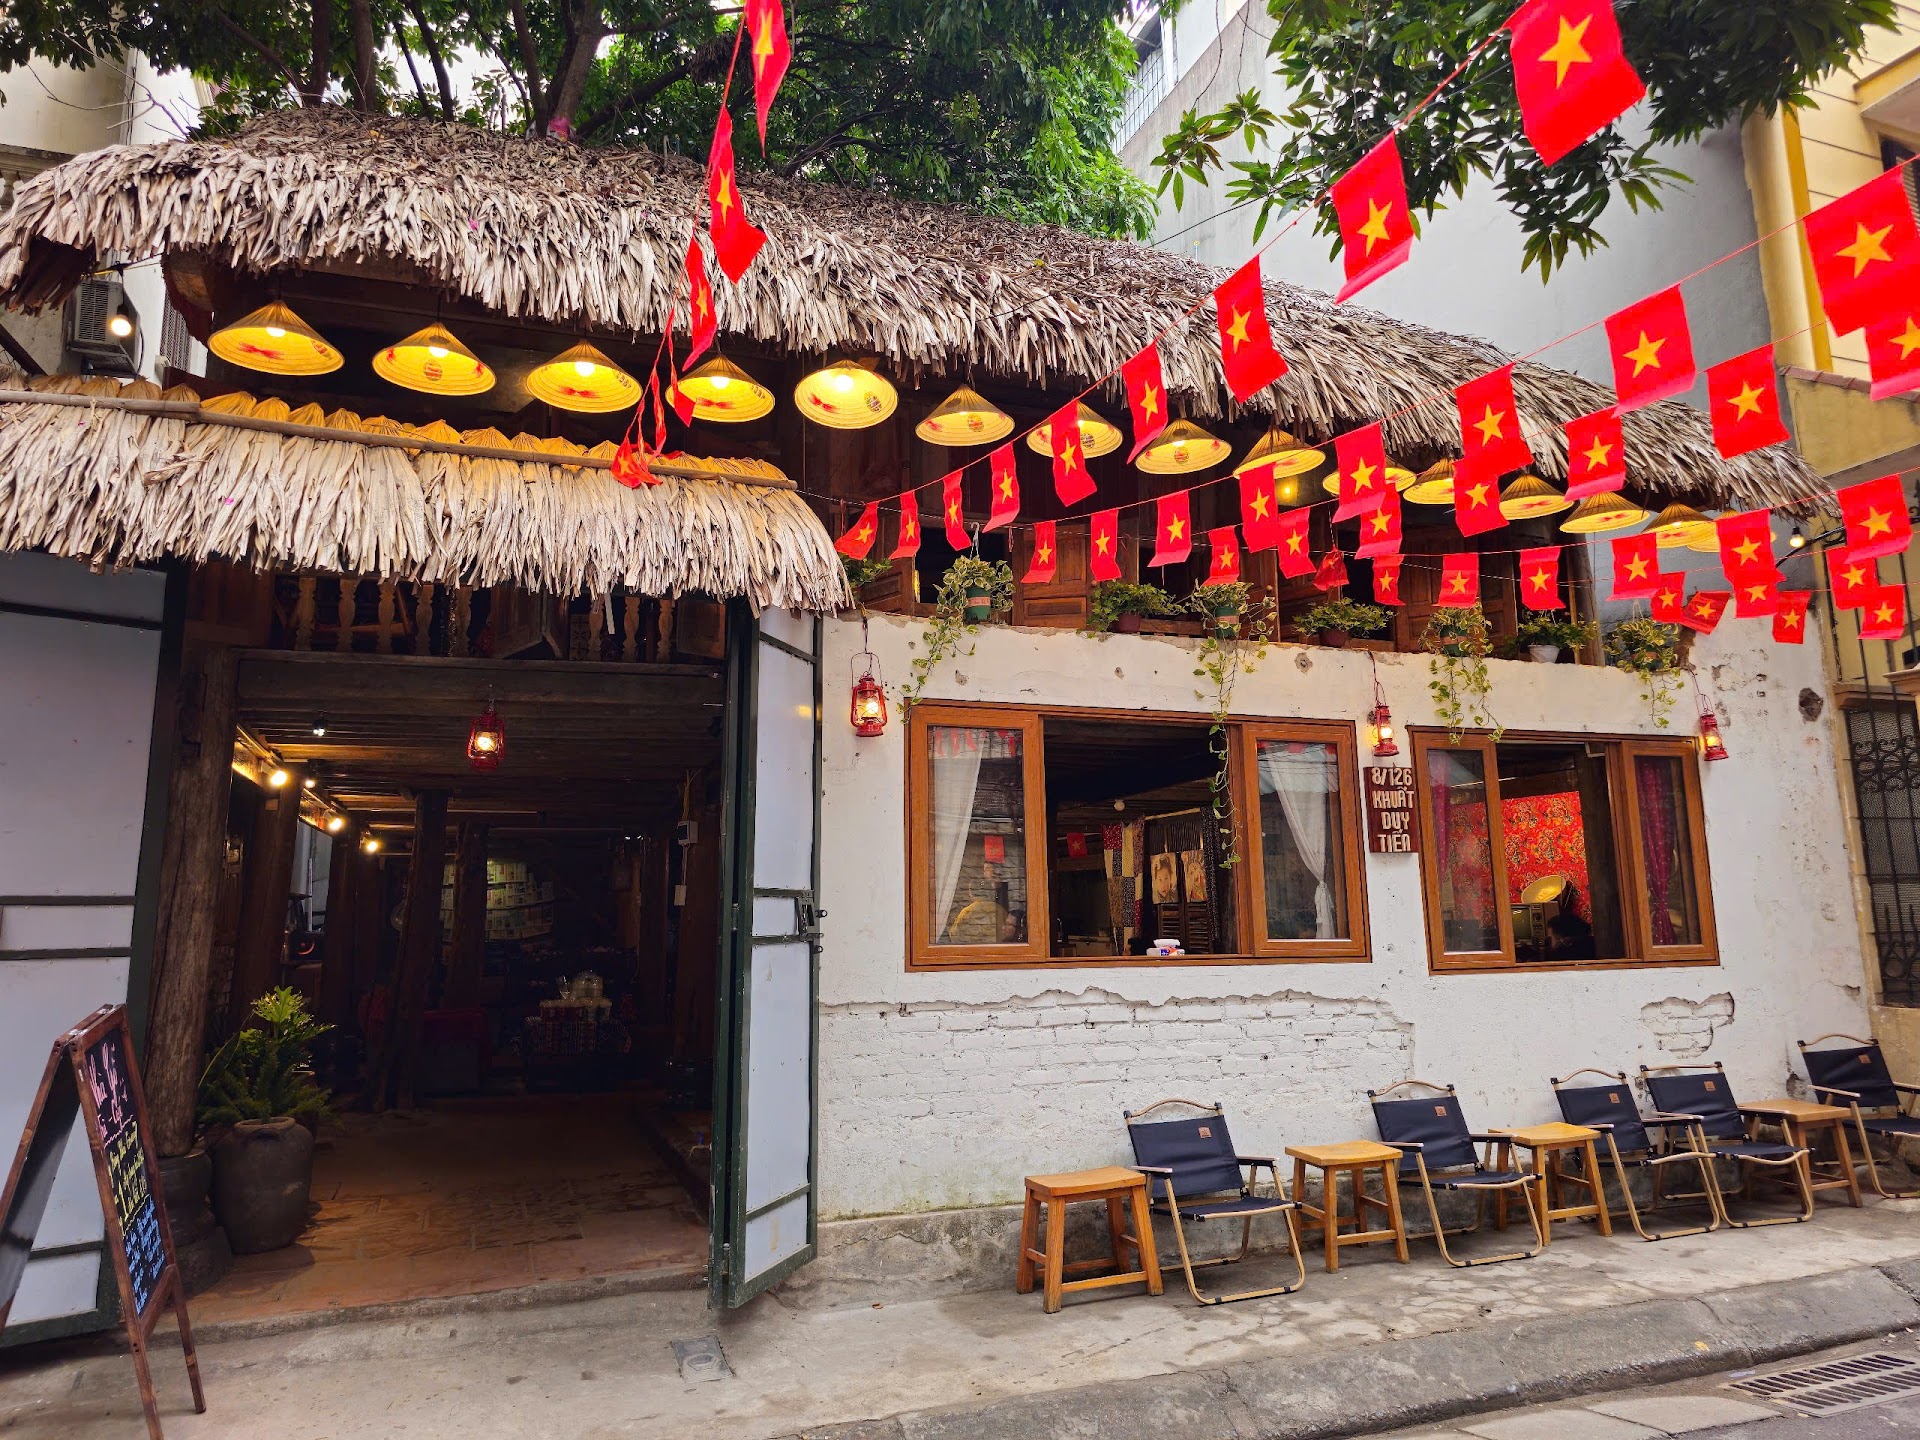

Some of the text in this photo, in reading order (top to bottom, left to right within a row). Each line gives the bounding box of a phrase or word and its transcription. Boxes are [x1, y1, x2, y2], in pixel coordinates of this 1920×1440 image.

[1371, 767, 1413, 787] 8/126
[1372, 786, 1414, 809] KHUẤT
[1381, 812, 1410, 830] DUY
